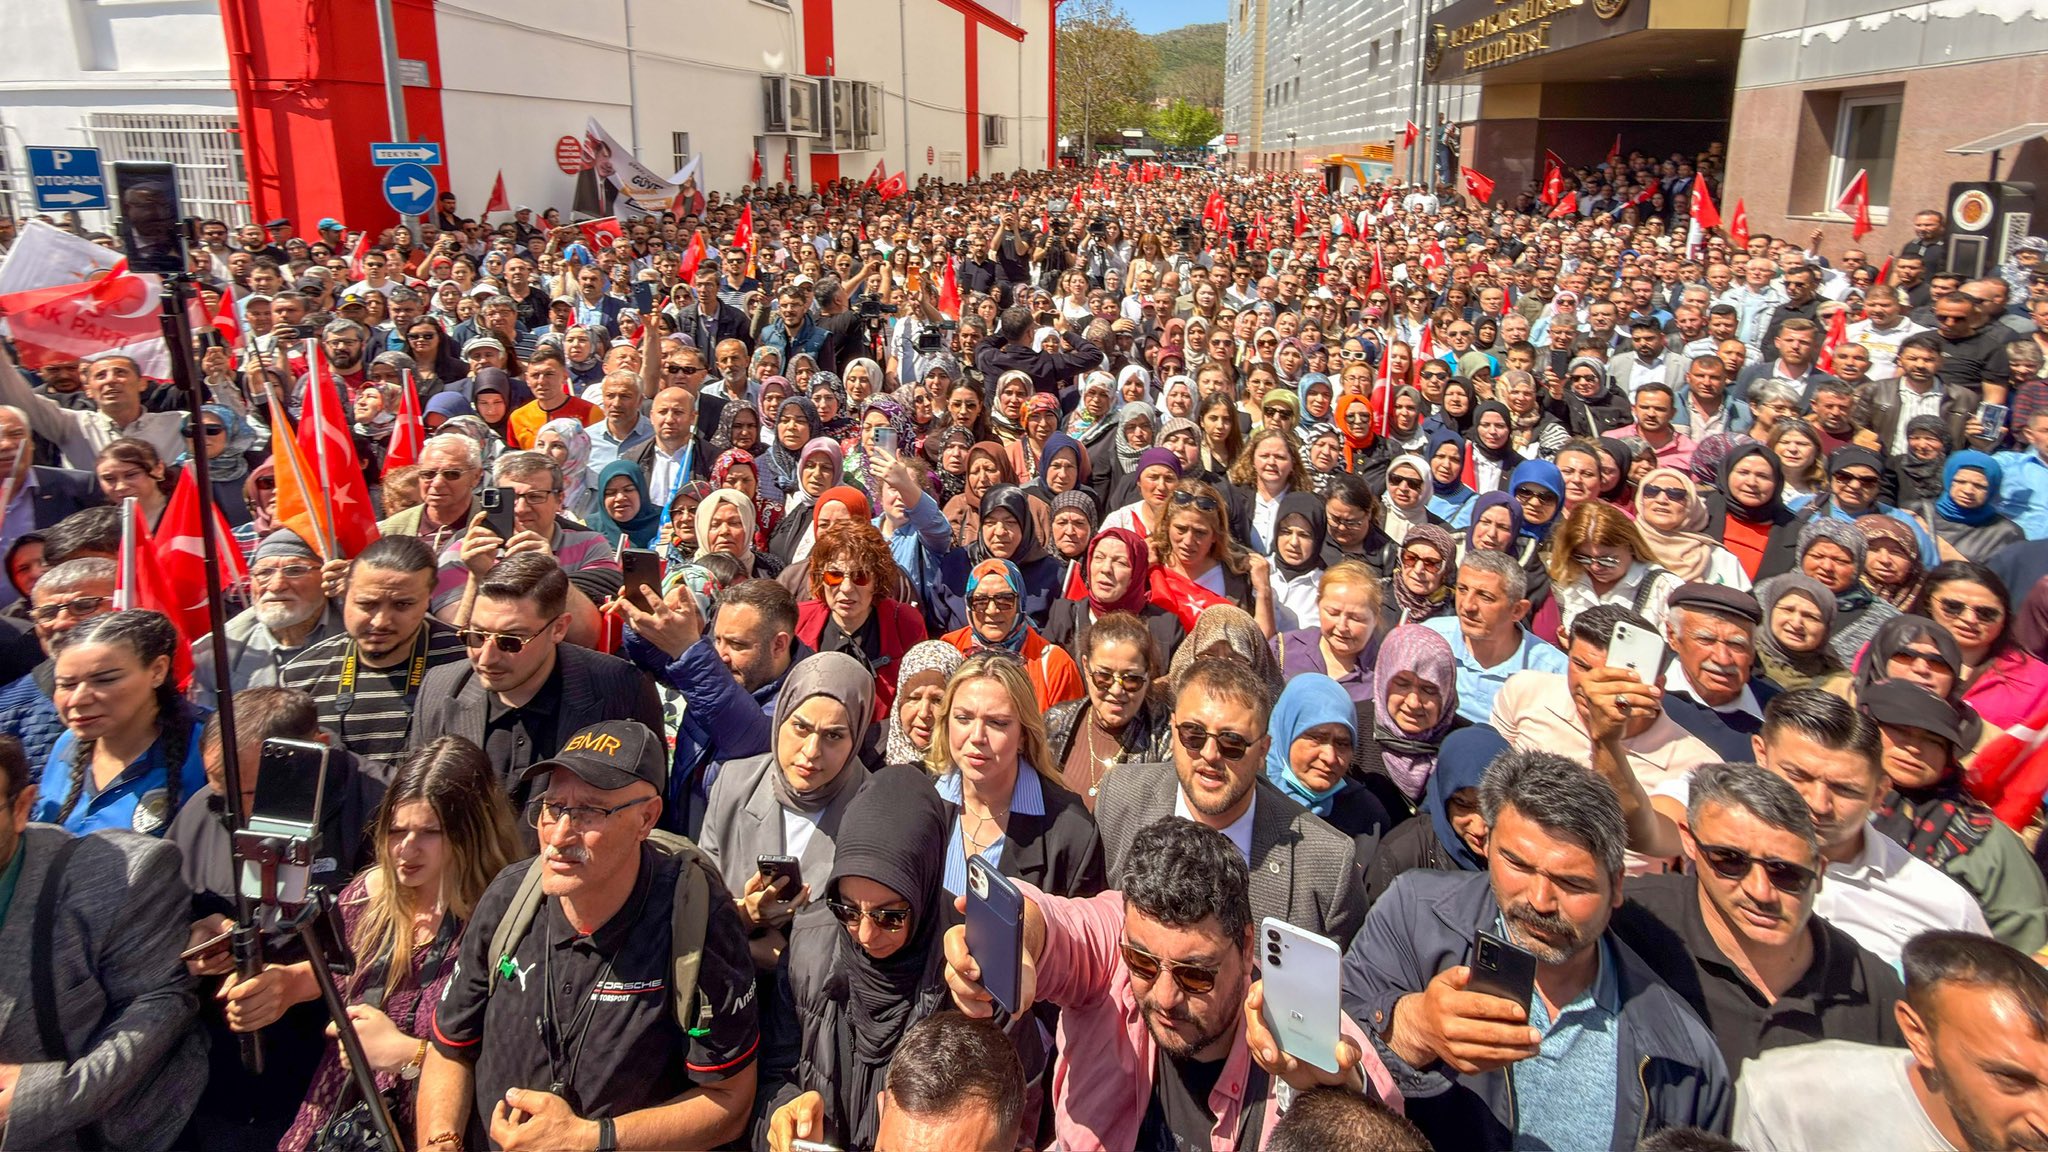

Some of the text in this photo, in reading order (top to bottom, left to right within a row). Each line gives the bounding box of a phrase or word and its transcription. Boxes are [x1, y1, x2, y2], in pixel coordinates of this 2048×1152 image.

[52, 150, 73, 170] P
[34, 175, 103, 186] OTOPARK
[341, 656, 354, 686] Nikon
[410, 656, 424, 686] Nikon
[564, 731, 621, 757] BMR
[590, 993, 632, 1002] MTORSPORT
